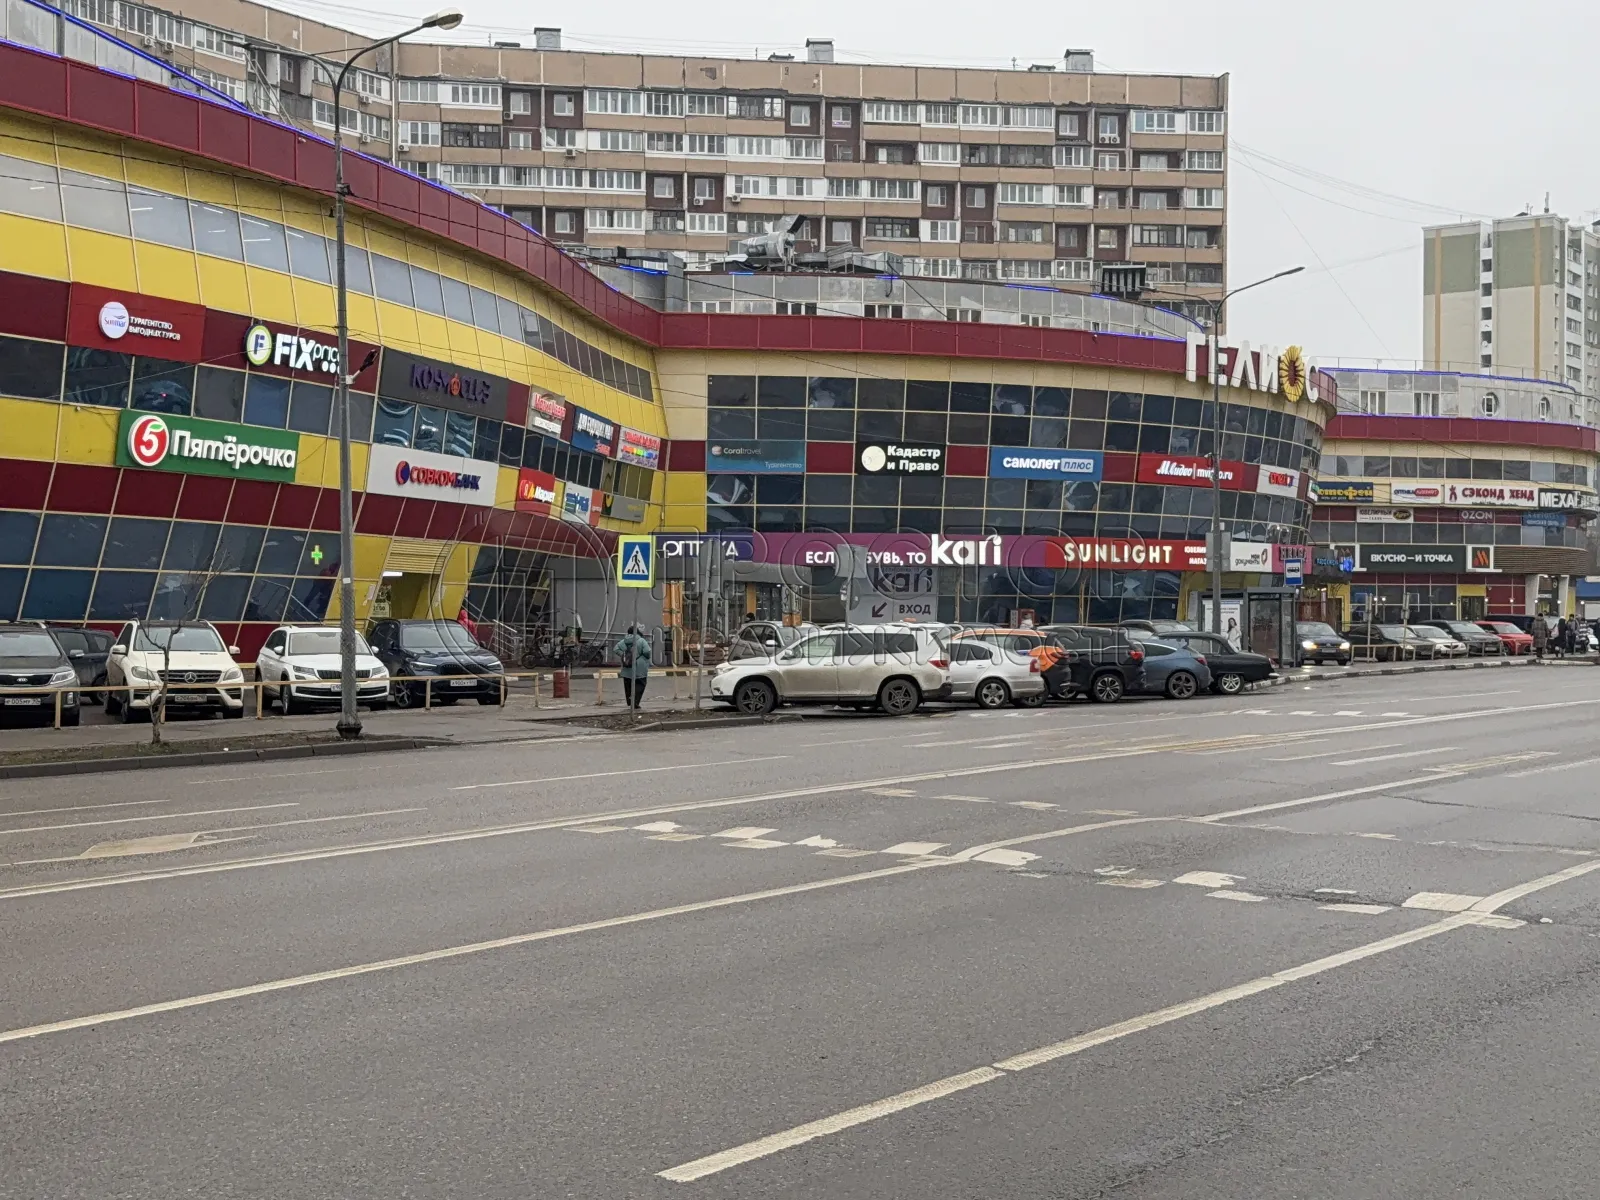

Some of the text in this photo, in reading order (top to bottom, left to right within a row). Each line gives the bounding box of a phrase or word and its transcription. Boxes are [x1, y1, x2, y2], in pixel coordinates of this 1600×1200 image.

[130, 316, 173, 330] ТУРАГЕНТСТВО
[128, 325, 181, 341] ВЫГОДНЫХ ТУРОВ
[170, 429, 296, 470] Пятёрочка
[887, 445, 941, 460] Кадастр
[887, 459, 940, 473] и Право
[1002, 456, 1092, 470] самолет плюс
[409, 465, 482, 490] СОВКОМБАНК
[1318, 486, 1373, 500] отофей
[1461, 487, 1535, 502] СЭКОНД ХЕНД
[1461, 510, 1493, 520] OZON
[663, 540, 739, 557] ОПТА
[805, 533, 1002, 566] ЕСЛ БУВЬ, ТО kari
[1063, 542, 1174, 564] SUNLIGHT
[1370, 553, 1407, 562] ВКУСНО
[1414, 554, 1422, 563] И
[1423, 554, 1454, 563] ТОЧКА
[873, 568, 933, 592] kari
[898, 604, 932, 615] ВХОД
